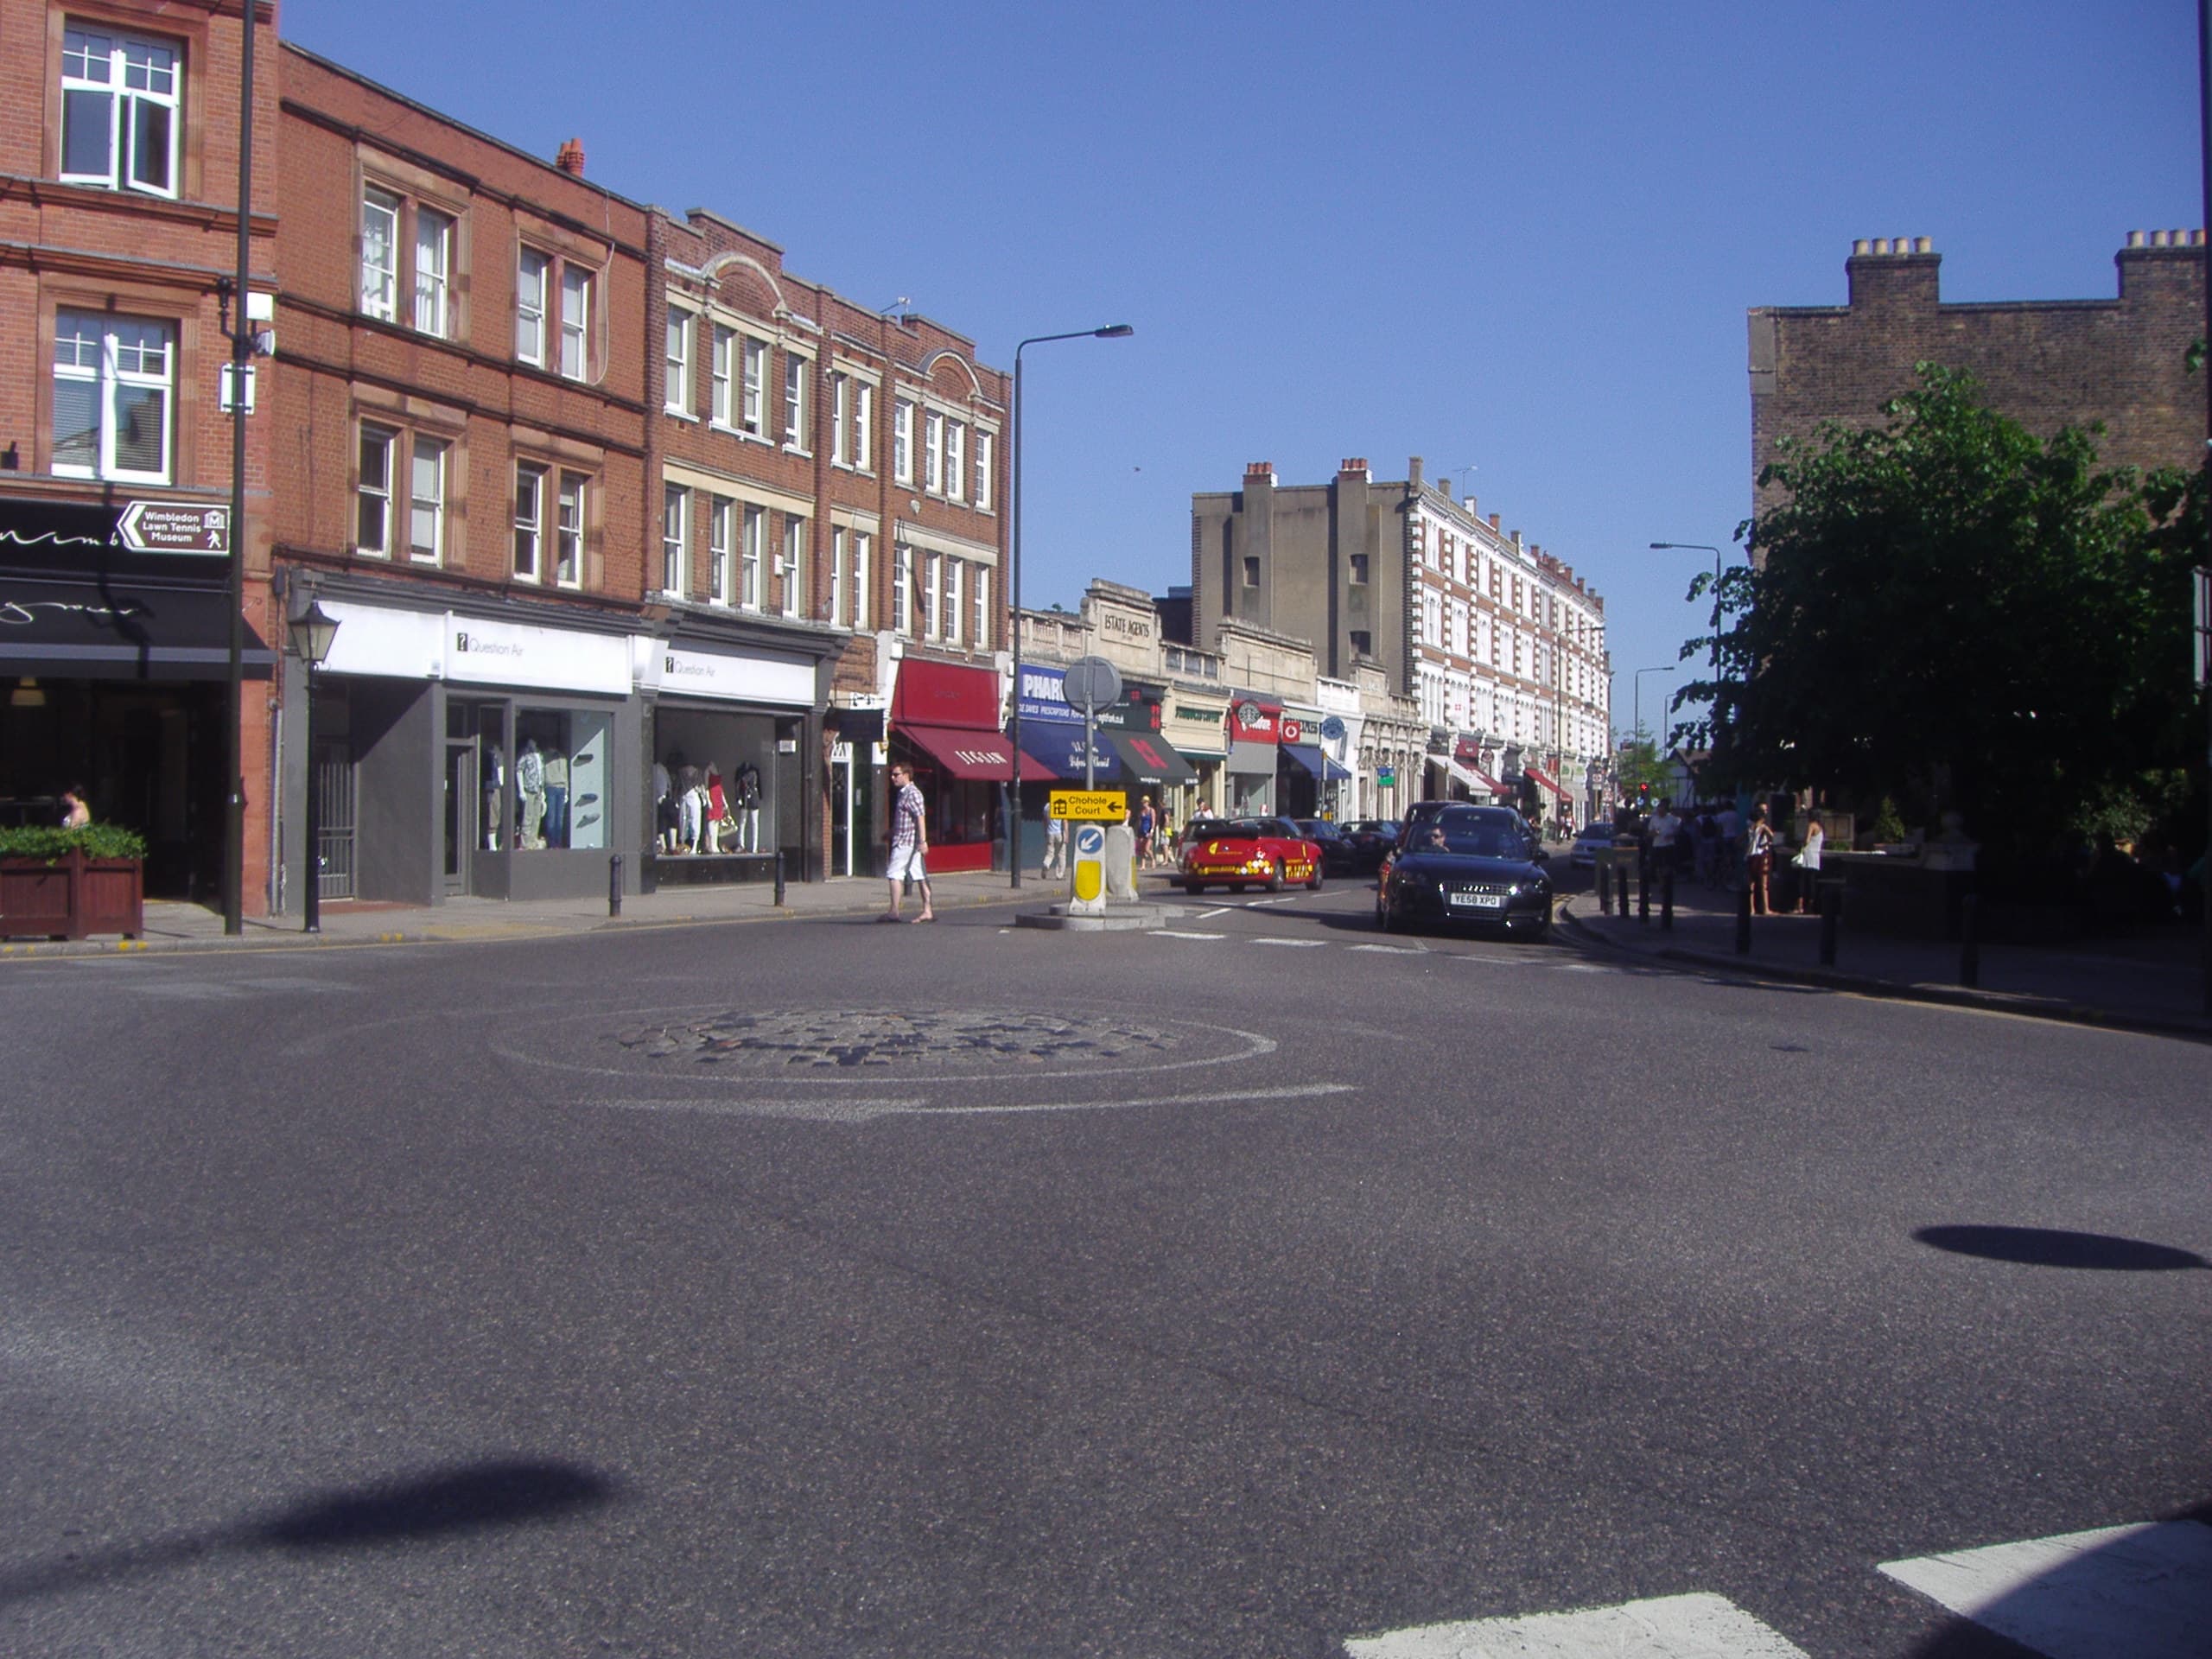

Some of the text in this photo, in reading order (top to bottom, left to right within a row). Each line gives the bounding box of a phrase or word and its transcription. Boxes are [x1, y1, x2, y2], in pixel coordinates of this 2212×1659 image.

[144, 512, 200, 523] Wimbledon
[143, 521, 201, 533] Lawn Tennis
[151, 531, 193, 543] Museum
[1104, 614, 1149, 638] ESTATE AGENTS
[469, 638, 523, 656] Question Air
[675, 660, 715, 677] Question Air
[954, 749, 1008, 766] JIGSAW
[1069, 796, 1107, 804] Chohole
[1075, 806, 1100, 815] Court
[1455, 894, 1478, 904] YE58
